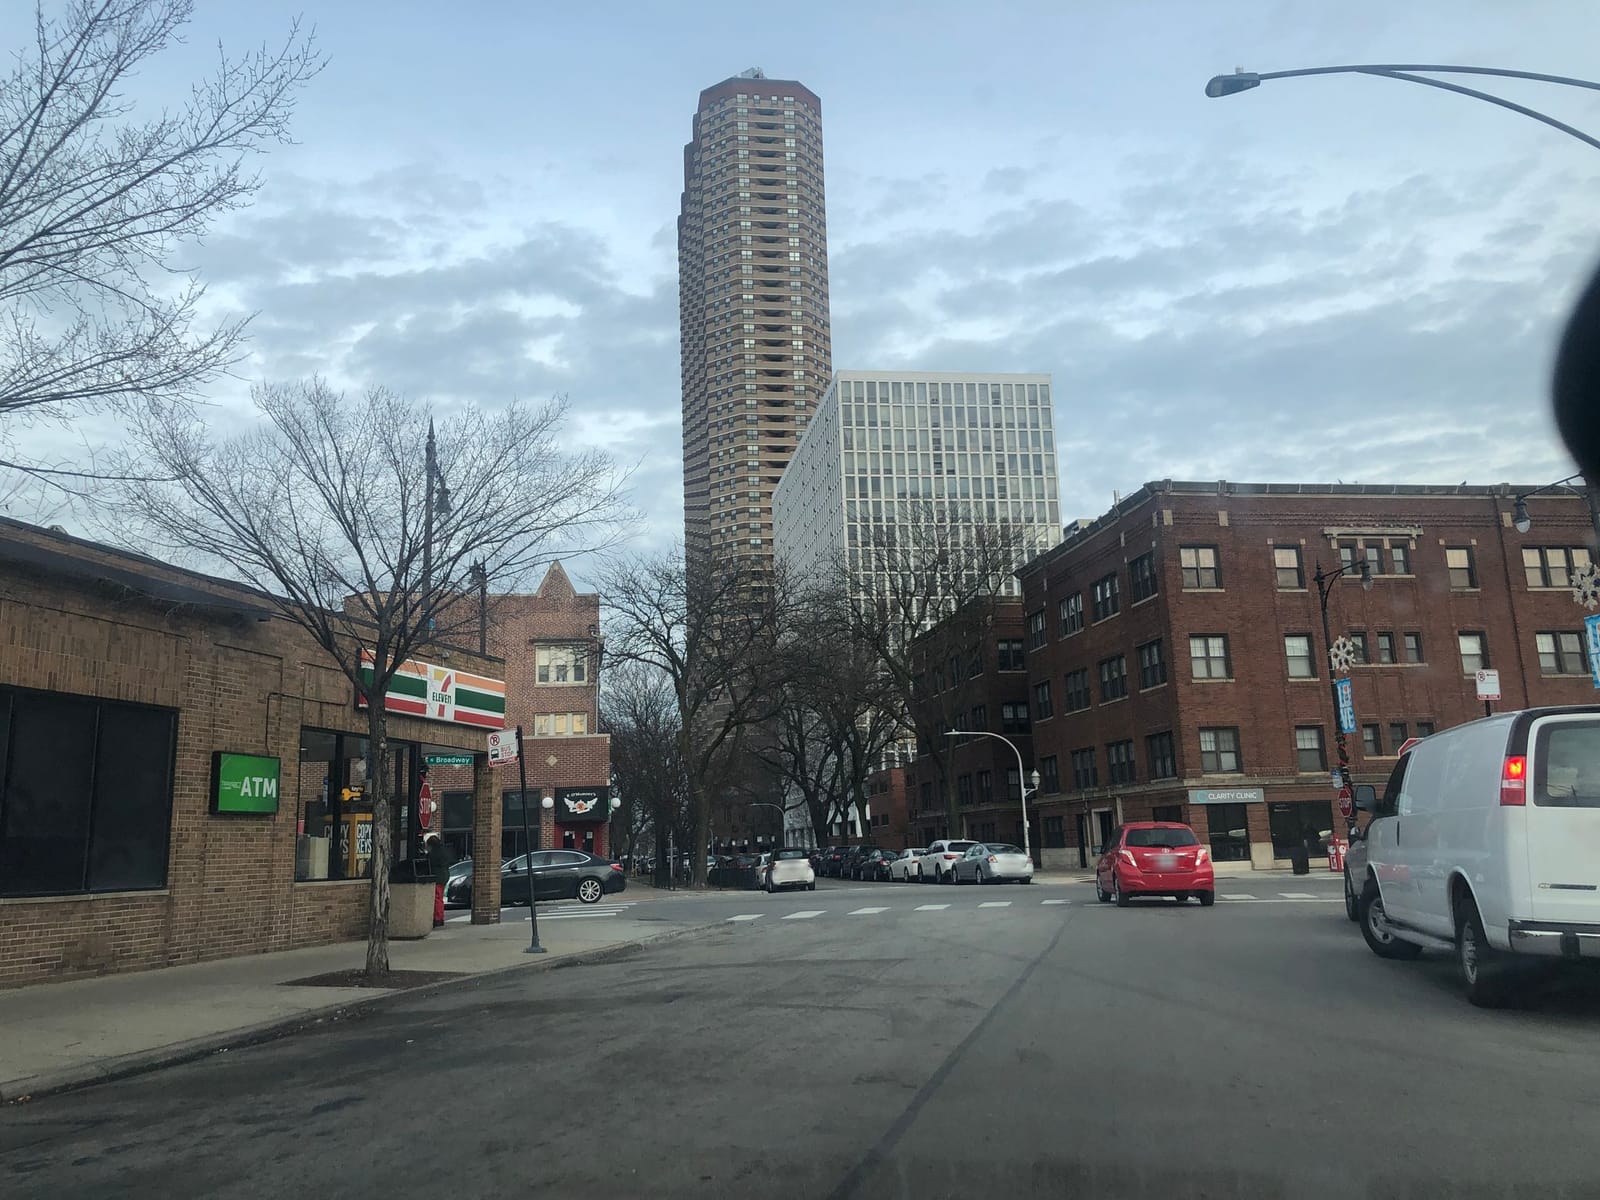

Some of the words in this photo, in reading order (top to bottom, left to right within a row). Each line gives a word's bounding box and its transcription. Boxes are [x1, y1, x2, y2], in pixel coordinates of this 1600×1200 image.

[433, 669, 452, 717] 7
[436, 756, 470, 764] Broadway
[240, 776, 277, 799] ATM
[1208, 792, 1234, 800] CLARITY
[1338, 797, 1351, 809] STOP
[420, 797, 432, 814] STOP
[356, 823, 373, 839] COPY
[356, 838, 372, 854] KEYS
